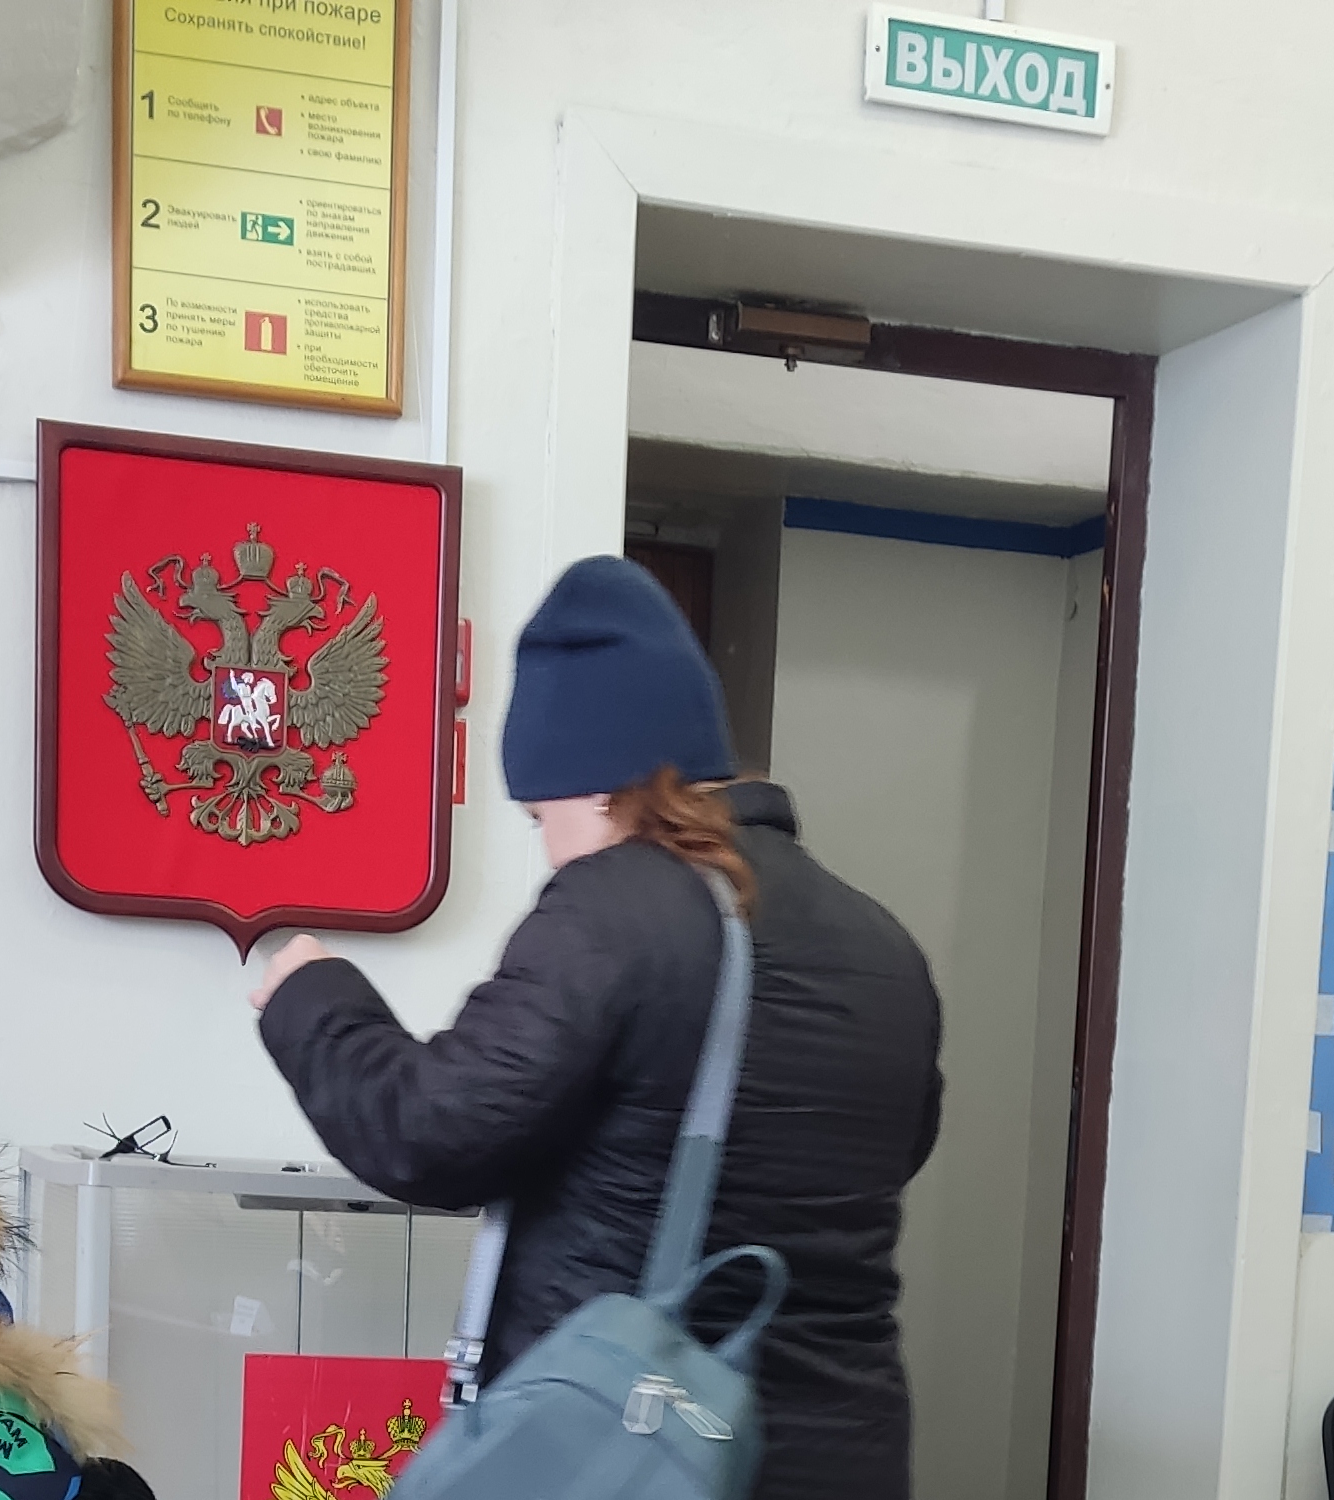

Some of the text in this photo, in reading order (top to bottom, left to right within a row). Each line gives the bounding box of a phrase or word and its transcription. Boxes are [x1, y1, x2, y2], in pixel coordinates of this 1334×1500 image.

[303, 0, 382, 25] пожаре
[163, 7, 367, 51] Сохранять спокойствие!
[895, 30, 1088, 117] ВЫХОД
[140, 89, 156, 121] 1
[183, 112, 232, 128] телефону
[140, 198, 161, 229] 2
[139, 303, 159, 334] 3
